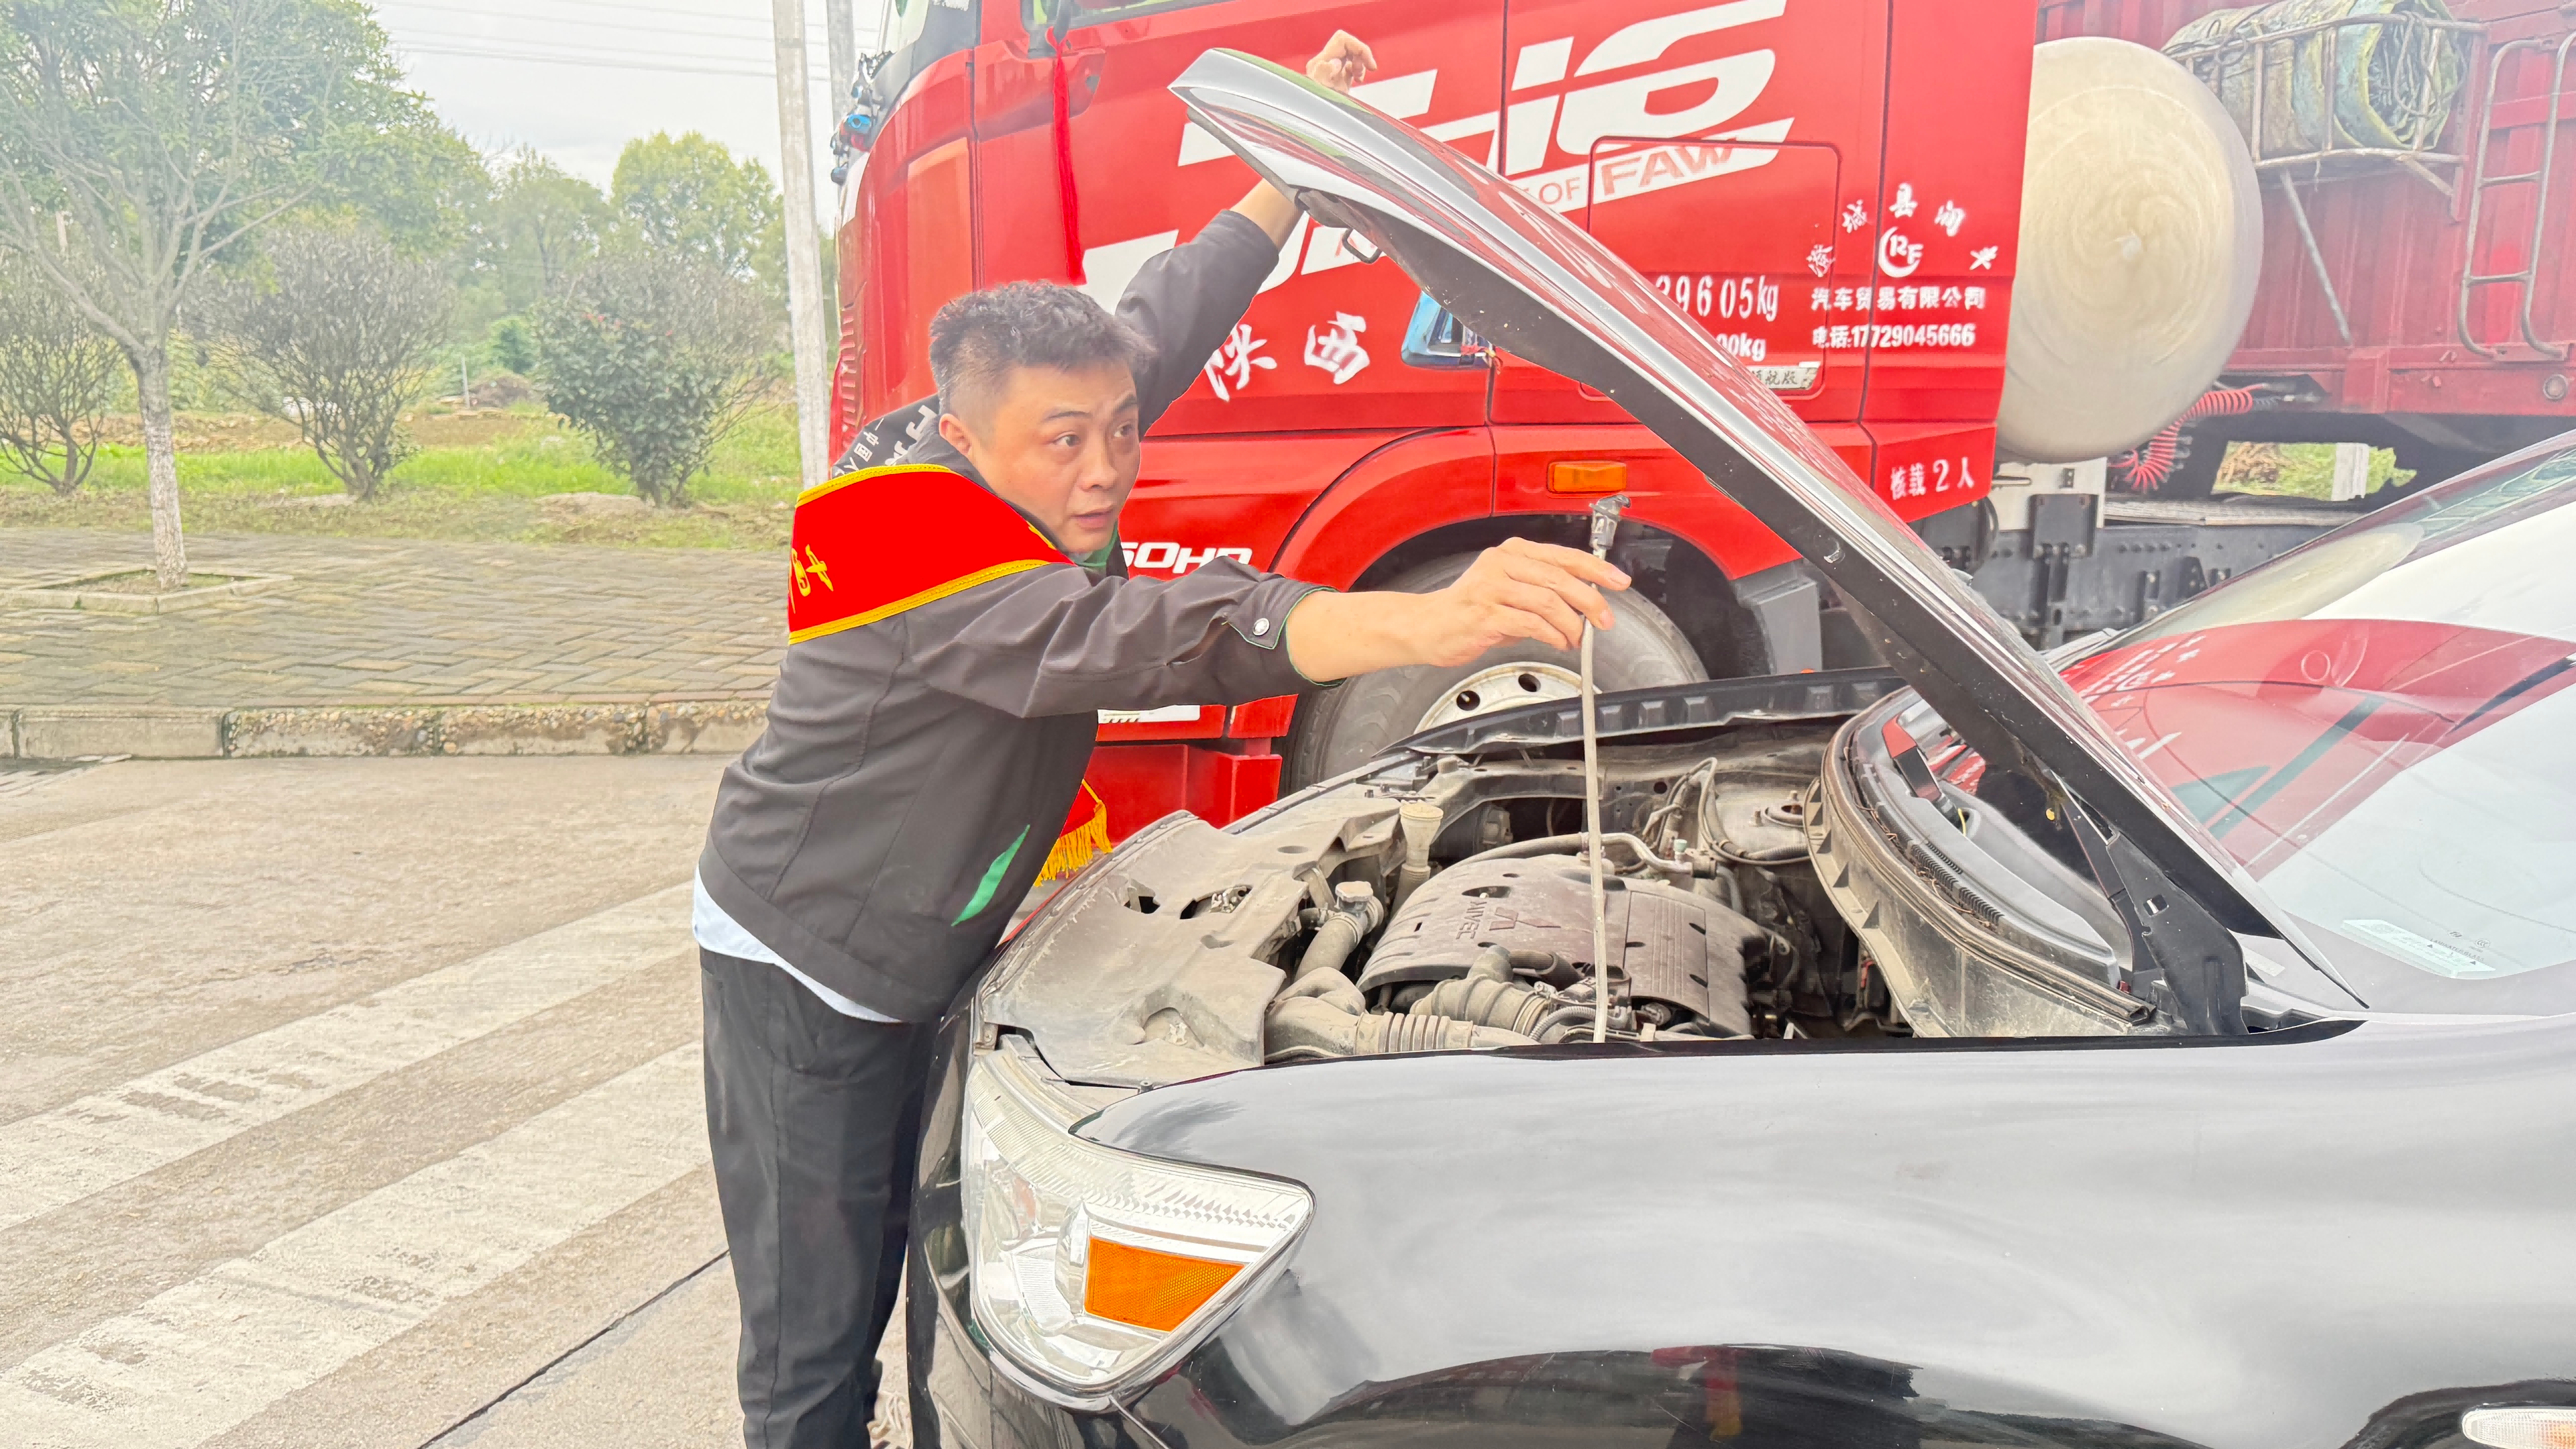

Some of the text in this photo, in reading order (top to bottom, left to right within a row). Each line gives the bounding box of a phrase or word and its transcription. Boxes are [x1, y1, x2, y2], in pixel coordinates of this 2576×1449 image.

[1538, 136, 1737, 205] OF FAW
[1811, 286, 1986, 311] 汽车贸易有限公司
[1204, 311, 1371, 403] 陕西
